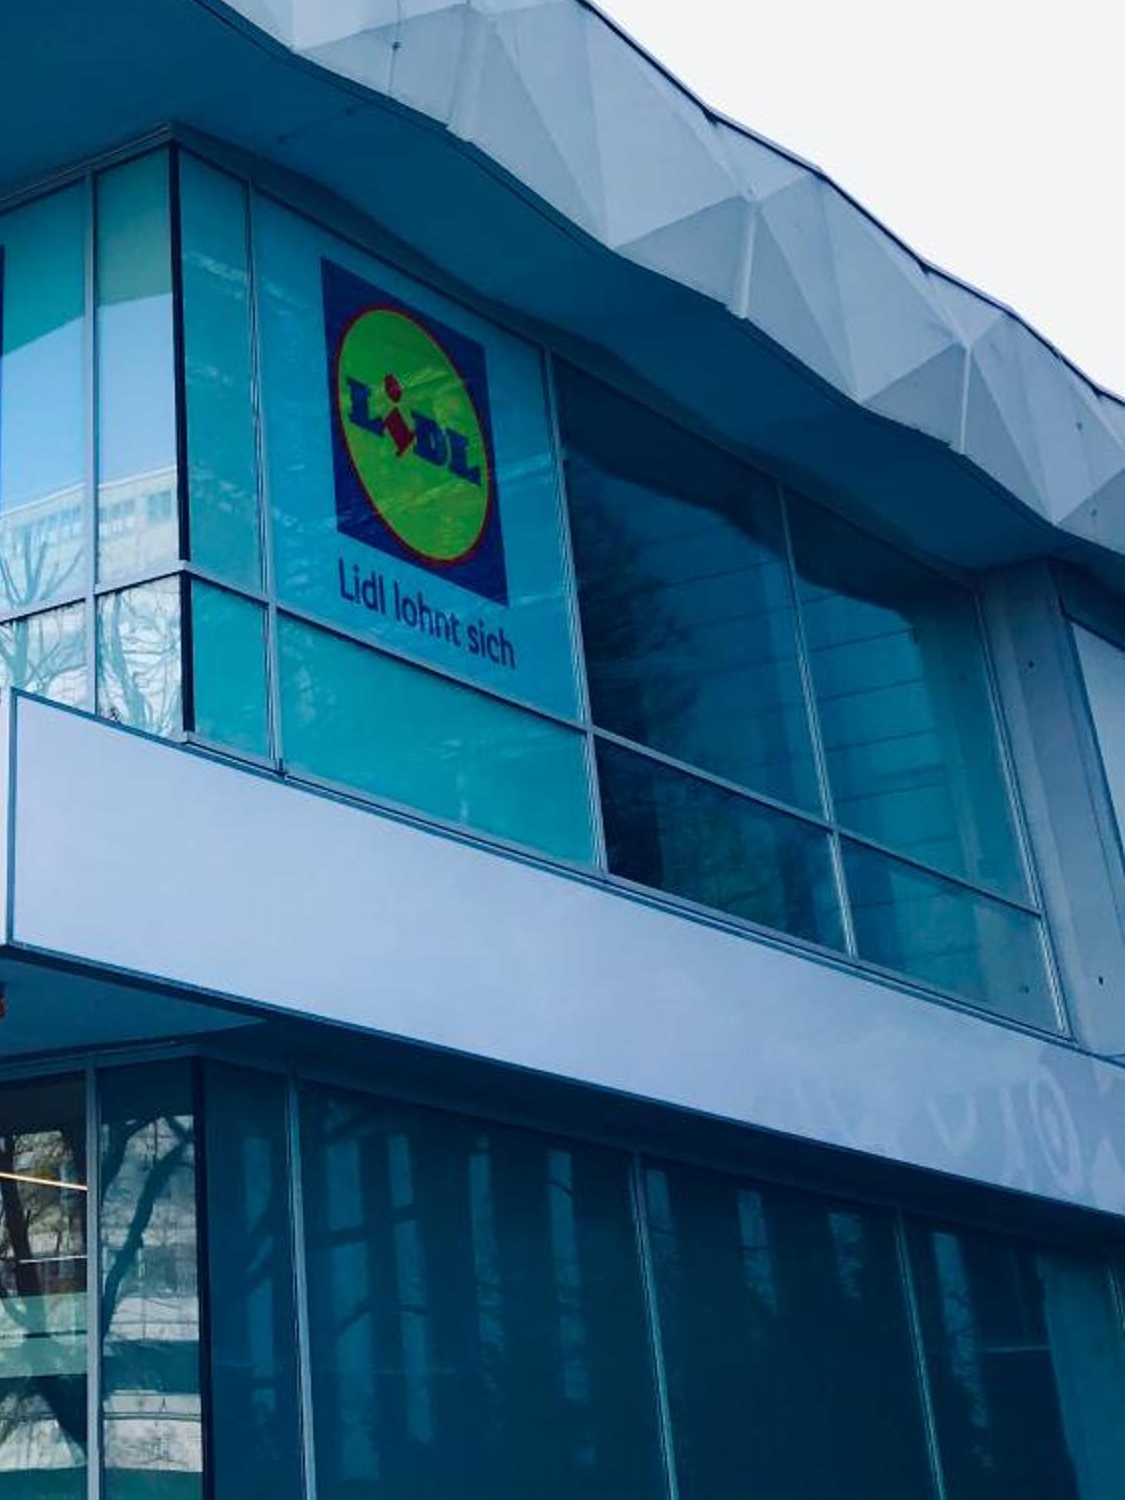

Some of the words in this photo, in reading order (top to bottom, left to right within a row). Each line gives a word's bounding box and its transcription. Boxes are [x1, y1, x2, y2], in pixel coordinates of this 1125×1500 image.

[338, 557, 385, 615] Lidl
[394, 579, 460, 648] lohnt
[467, 622, 515, 670] sich
